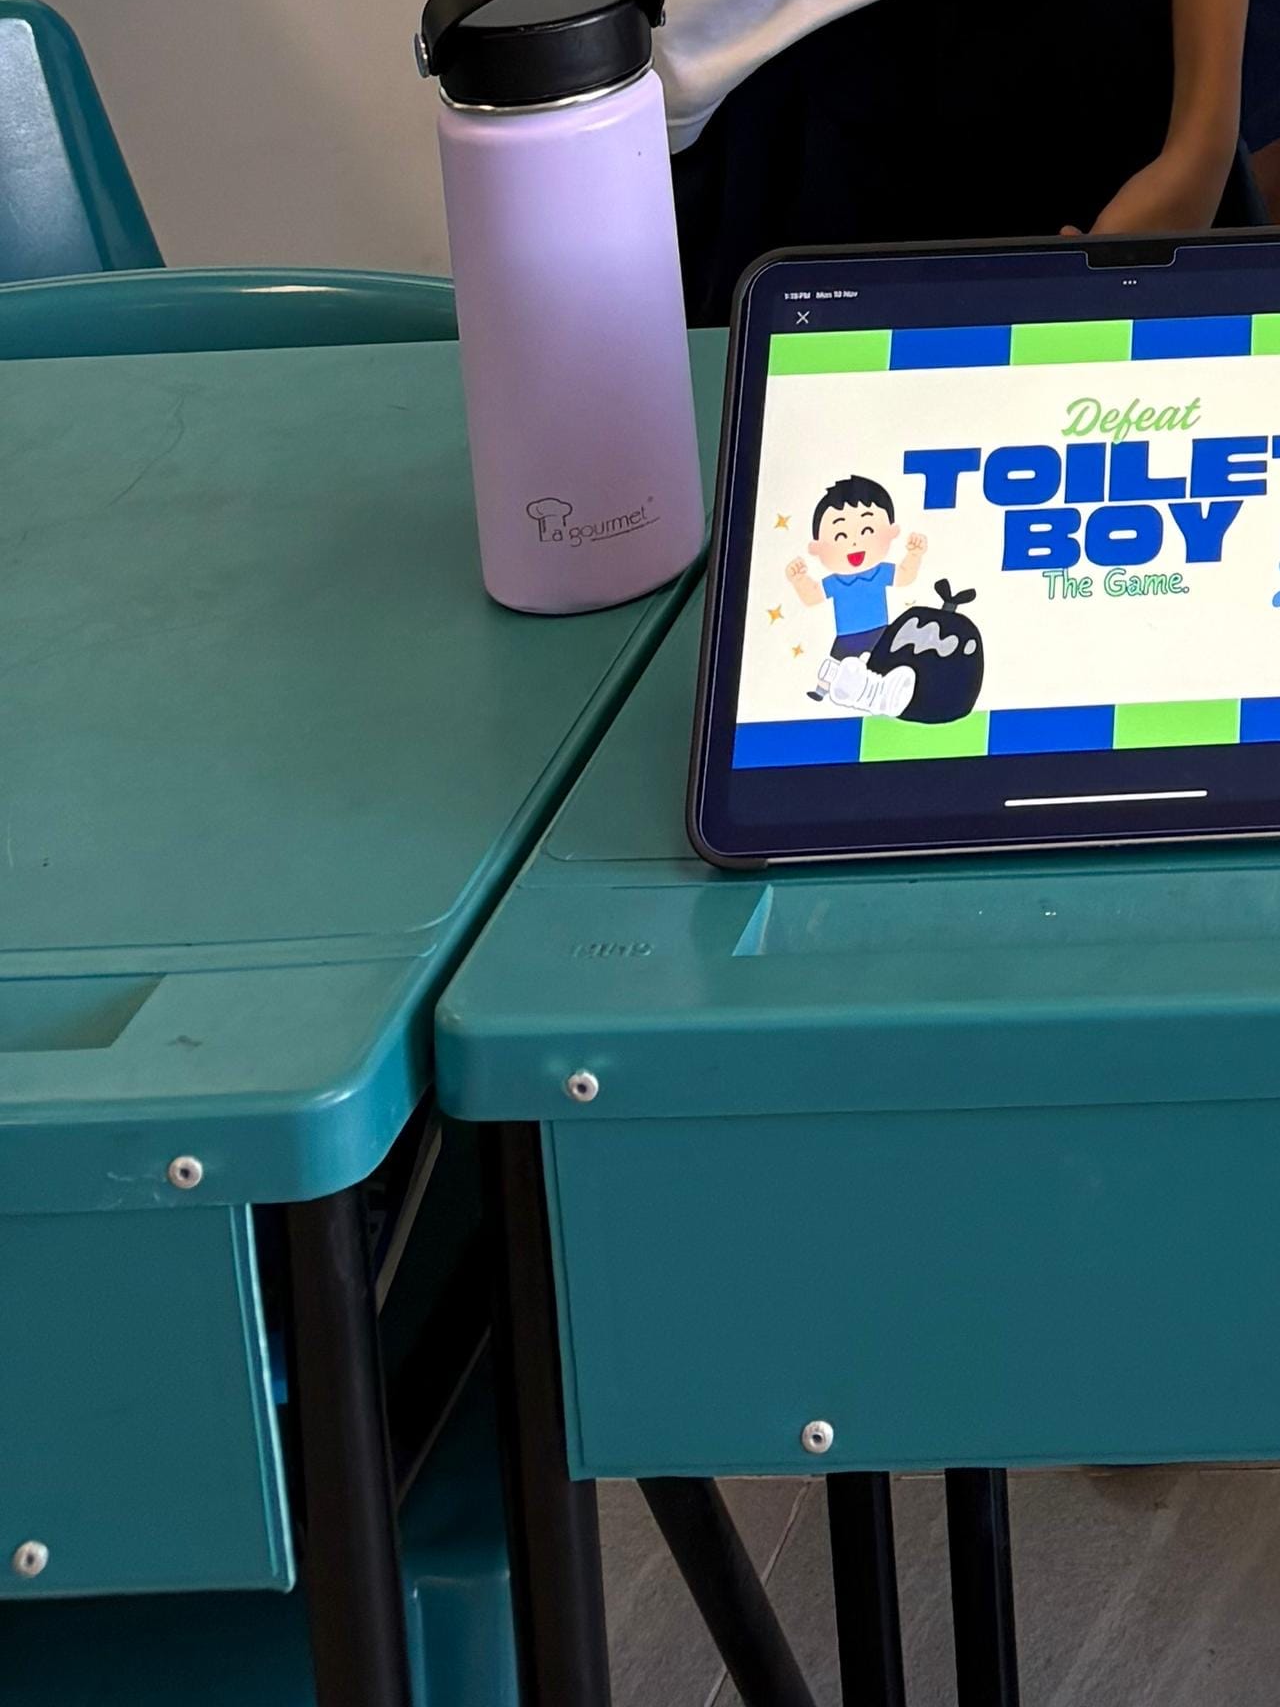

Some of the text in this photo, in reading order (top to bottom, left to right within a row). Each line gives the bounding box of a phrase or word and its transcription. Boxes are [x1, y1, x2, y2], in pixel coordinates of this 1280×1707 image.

[1062, 396, 1202, 444] Defeat
[539, 506, 648, 547] La gourmet
[1001, 501, 1245, 573] BOY
[1043, 568, 1190, 602] The Game.
